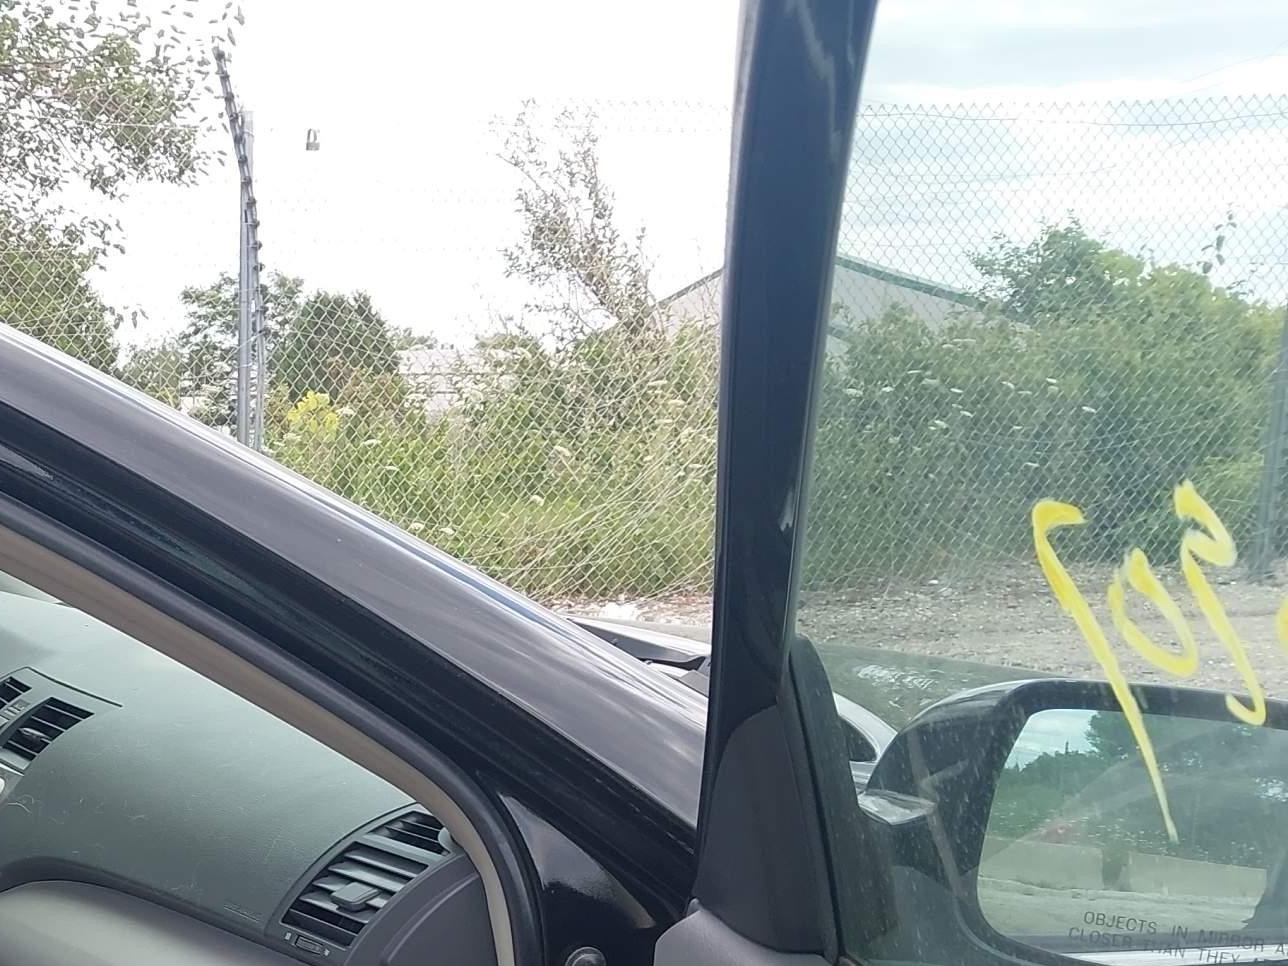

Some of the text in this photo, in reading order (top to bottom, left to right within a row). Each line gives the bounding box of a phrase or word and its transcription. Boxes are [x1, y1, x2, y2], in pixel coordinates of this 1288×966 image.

[1069, 927, 1133, 949] CLOSER
[1198, 947, 1241, 965] THEY
[1083, 911, 1158, 935] OBJECTS
[1172, 925, 1189, 941] IN
[1199, 930, 1265, 953] MIRROR
